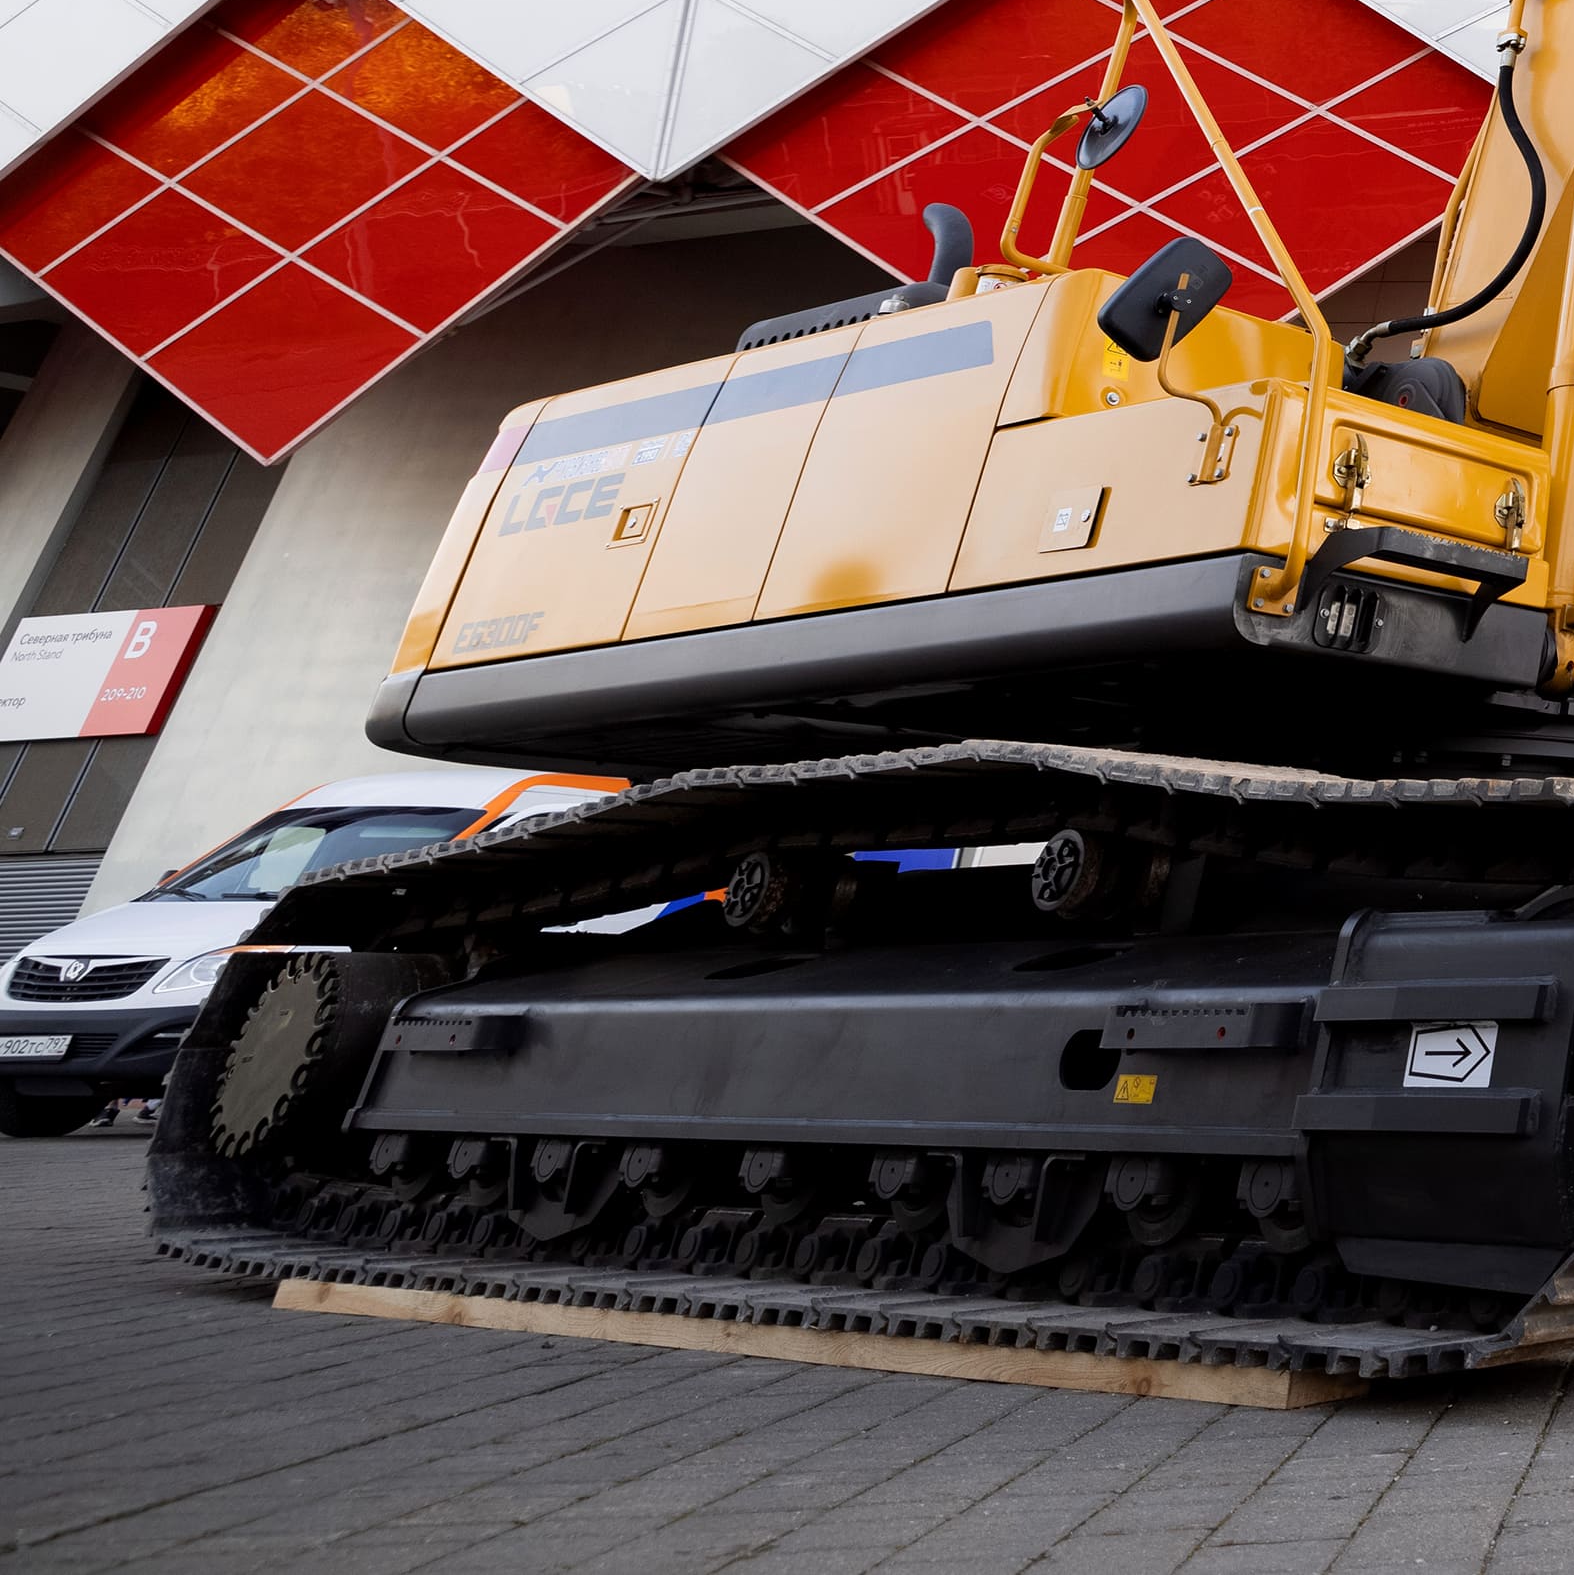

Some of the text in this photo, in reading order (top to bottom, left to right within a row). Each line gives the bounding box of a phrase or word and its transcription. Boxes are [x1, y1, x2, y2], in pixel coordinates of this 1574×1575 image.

[498, 473, 626, 537] LGCE
[20, 628, 113, 647] Северная трибуна
[11, 650, 37, 662] North
[100, 686, 147, 702] 209-210
[0, 1037, 68, 1055] 902ТС 797
